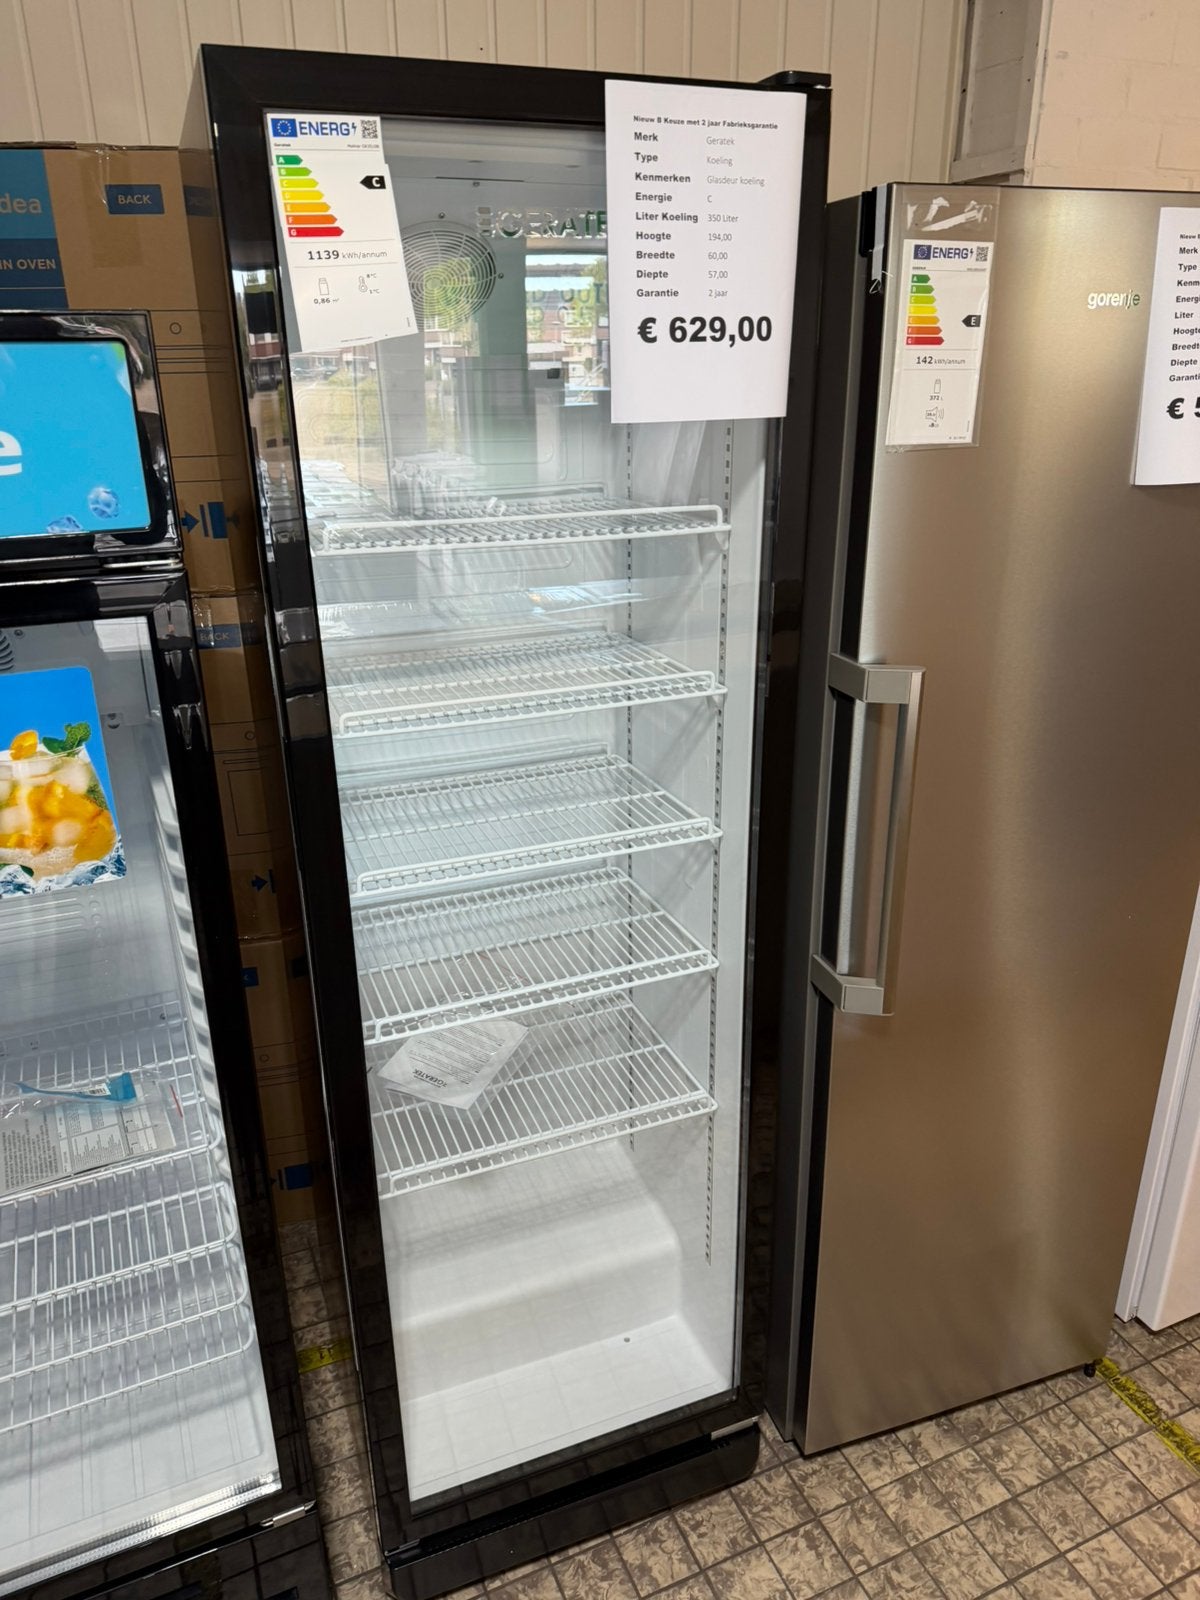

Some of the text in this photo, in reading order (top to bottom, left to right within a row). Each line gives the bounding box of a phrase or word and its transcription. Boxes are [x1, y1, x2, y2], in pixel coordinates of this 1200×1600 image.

[633, 115, 655, 123] Nieuw
[663, 117, 685, 126] Keuze
[722, 120, 778, 130] Fabrieksgarantie
[634, 132, 735, 146] Merk Geratek
[634, 152, 733, 167] Type Koeling
[372, 177, 381, 187] C
[635, 172, 765, 187] Kenmerken Glasdeur koeling
[118, 194, 152, 205] BACK
[635, 192, 712, 204] Energie C
[635, 212, 739, 223] Liter Koeling 350 Liter
[636, 231, 732, 242] Hoogte 194,00
[308, 249, 388, 260] 1139 kWh/annum
[636, 251, 728, 261] Breedte 60,00
[16, 258, 56, 270] OVEN
[1178, 263, 1197, 272] Type
[636, 269, 728, 280] Diepte 57,00
[1177, 279, 1200, 287] Kenm
[636, 288, 728, 298] Garantie 2 jaar
[1088, 289, 1141, 310] gorenje
[1174, 311, 1194, 319] Liter
[970, 317, 976, 326] E
[637, 315, 773, 348] € 629,00
[916, 356, 934, 364] 142
[1170, 359, 1198, 367] Diepte
[1166, 397, 1185, 420] €
